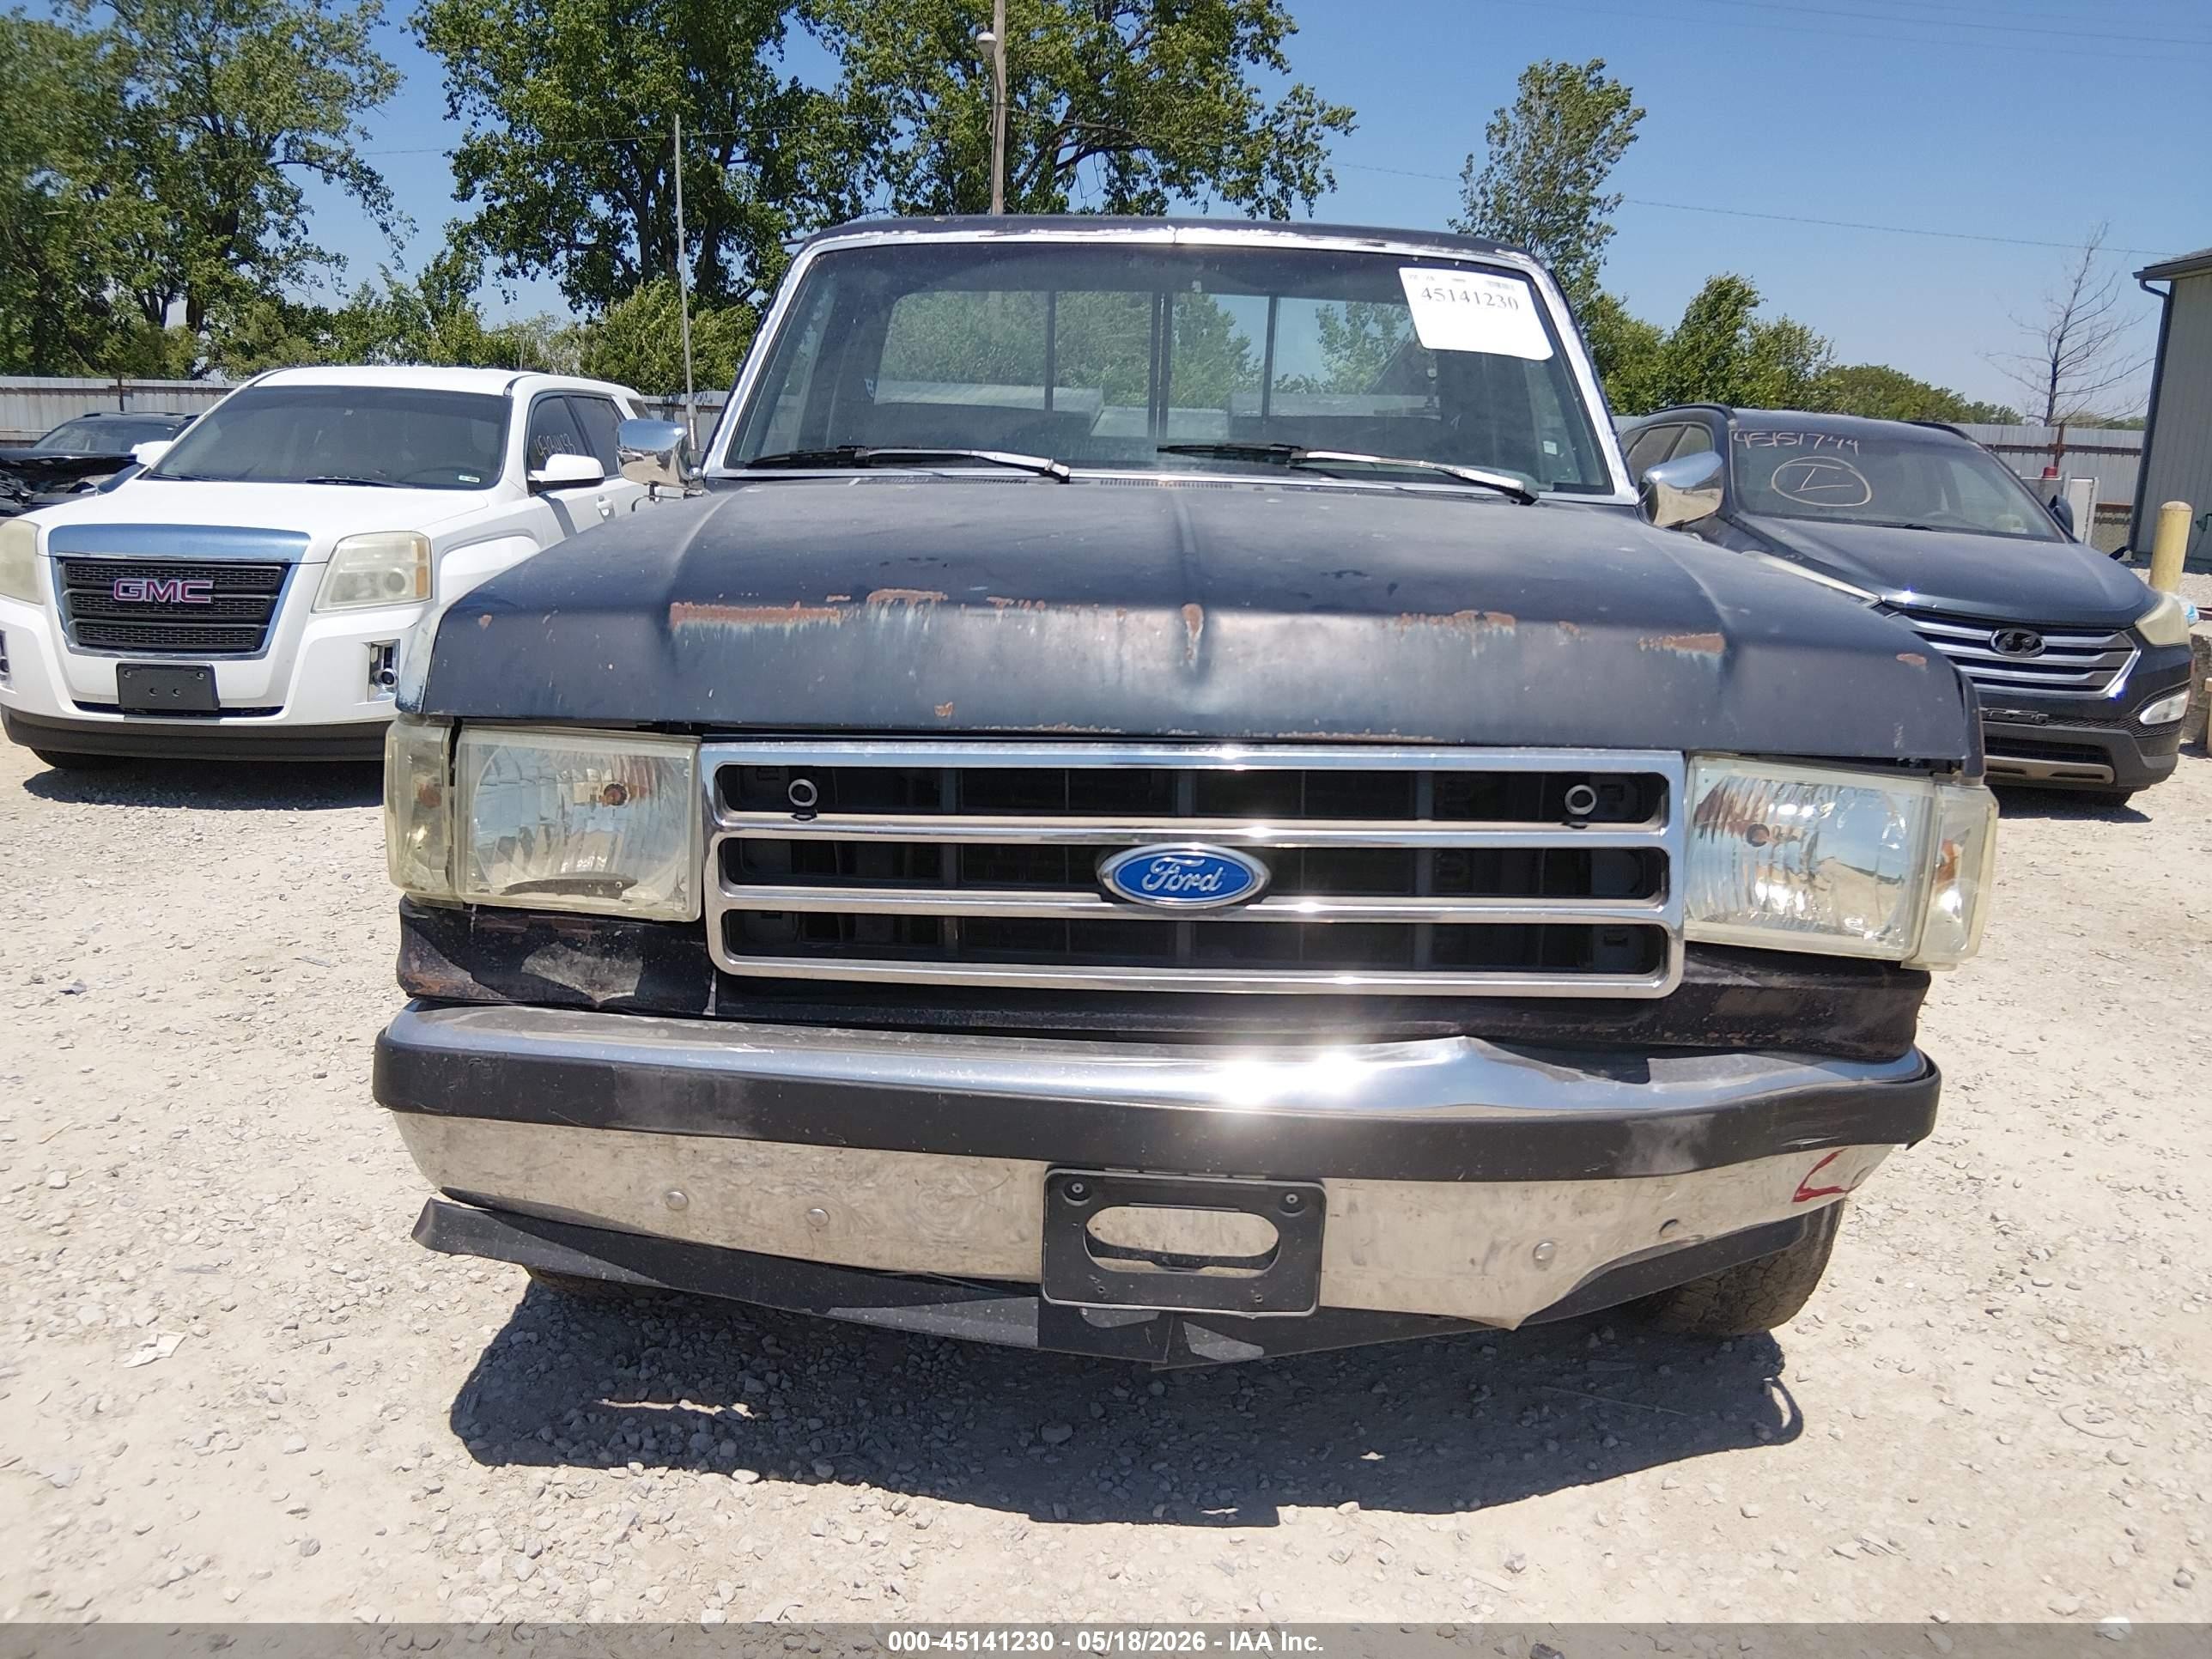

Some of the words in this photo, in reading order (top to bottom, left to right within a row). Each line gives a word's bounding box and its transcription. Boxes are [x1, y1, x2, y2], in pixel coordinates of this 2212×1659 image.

[1421, 286, 1519, 311] 45141230
[113, 578, 214, 604] GMC
[1141, 857, 1224, 891] Ford
